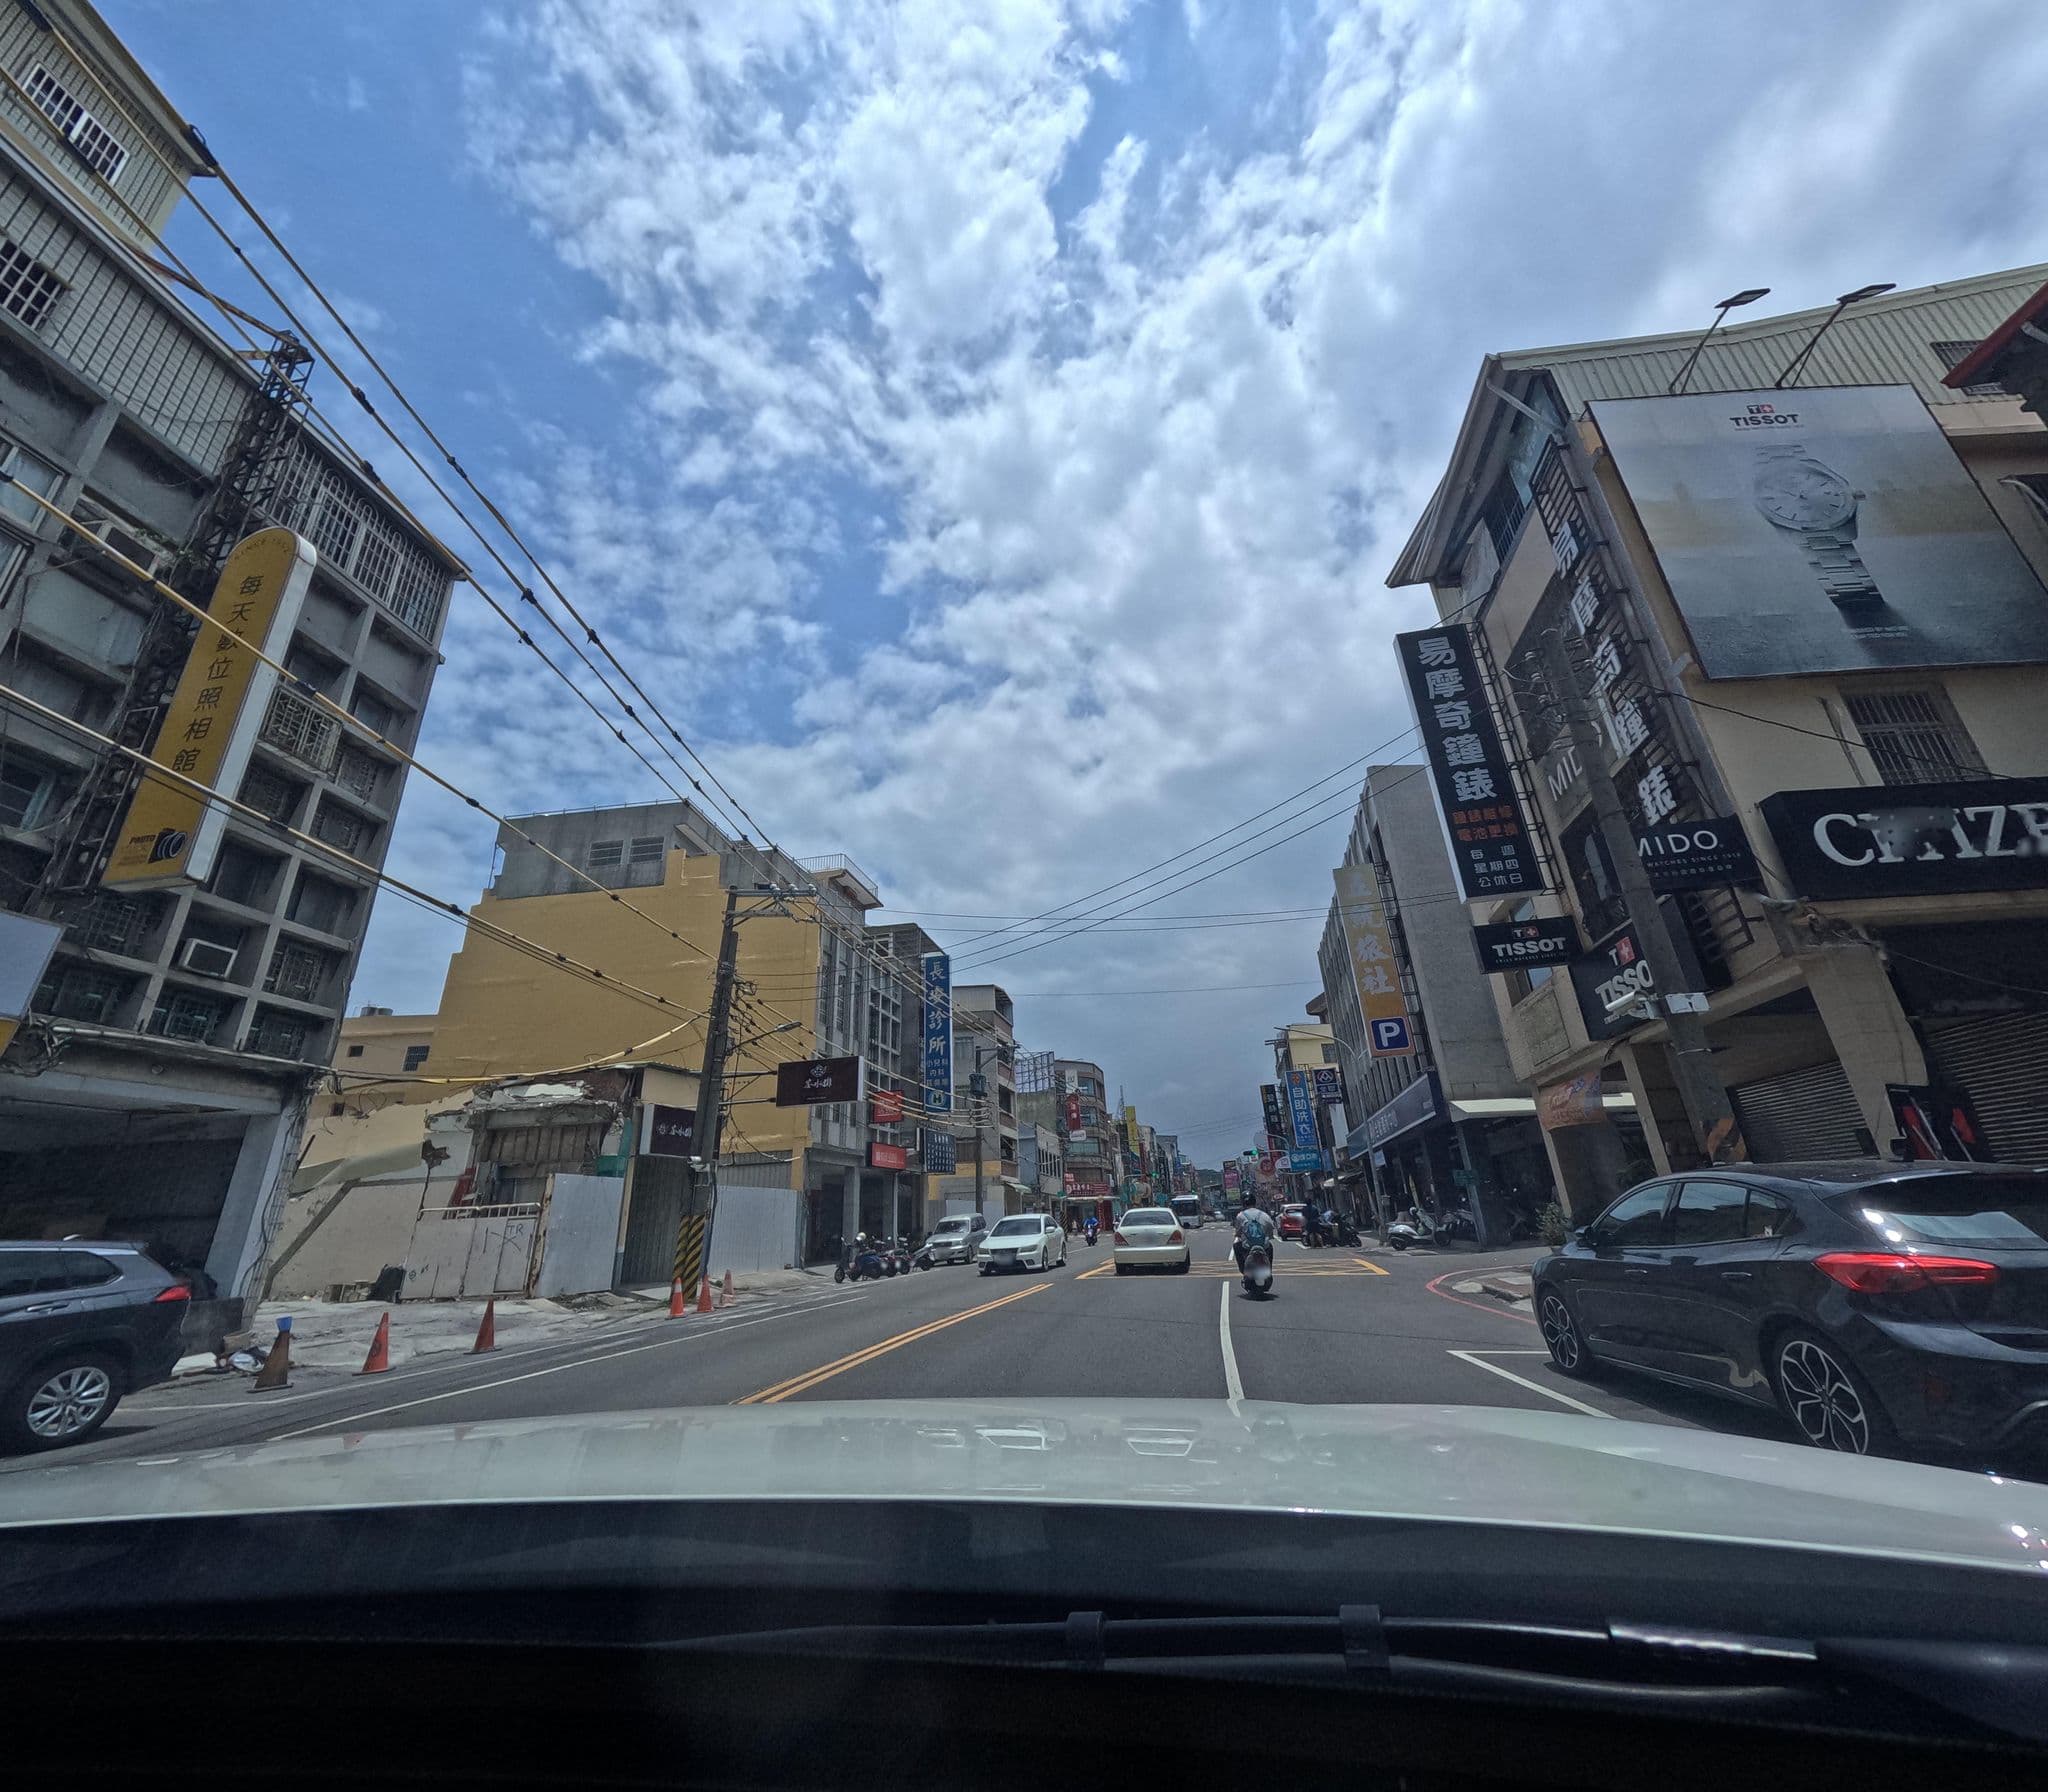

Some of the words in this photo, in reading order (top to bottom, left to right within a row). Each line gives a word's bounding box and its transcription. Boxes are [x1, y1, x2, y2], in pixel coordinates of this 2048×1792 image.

[1729, 414, 1799, 427] TISSOT
[171, 575, 264, 772] 每天數位照相館
[1417, 636, 1498, 802] 易摩奇鐘錶
[1474, 859, 1519, 874] 星期四
[1478, 873, 1524, 887] 公休日
[1491, 937, 1567, 957] TISSOT
[1595, 959, 1655, 1008] TISSO
[928, 961, 948, 1056] 長安診所
[1379, 1022, 1401, 1048] P
[1292, 1087, 1312, 1135] 自助洗衣
